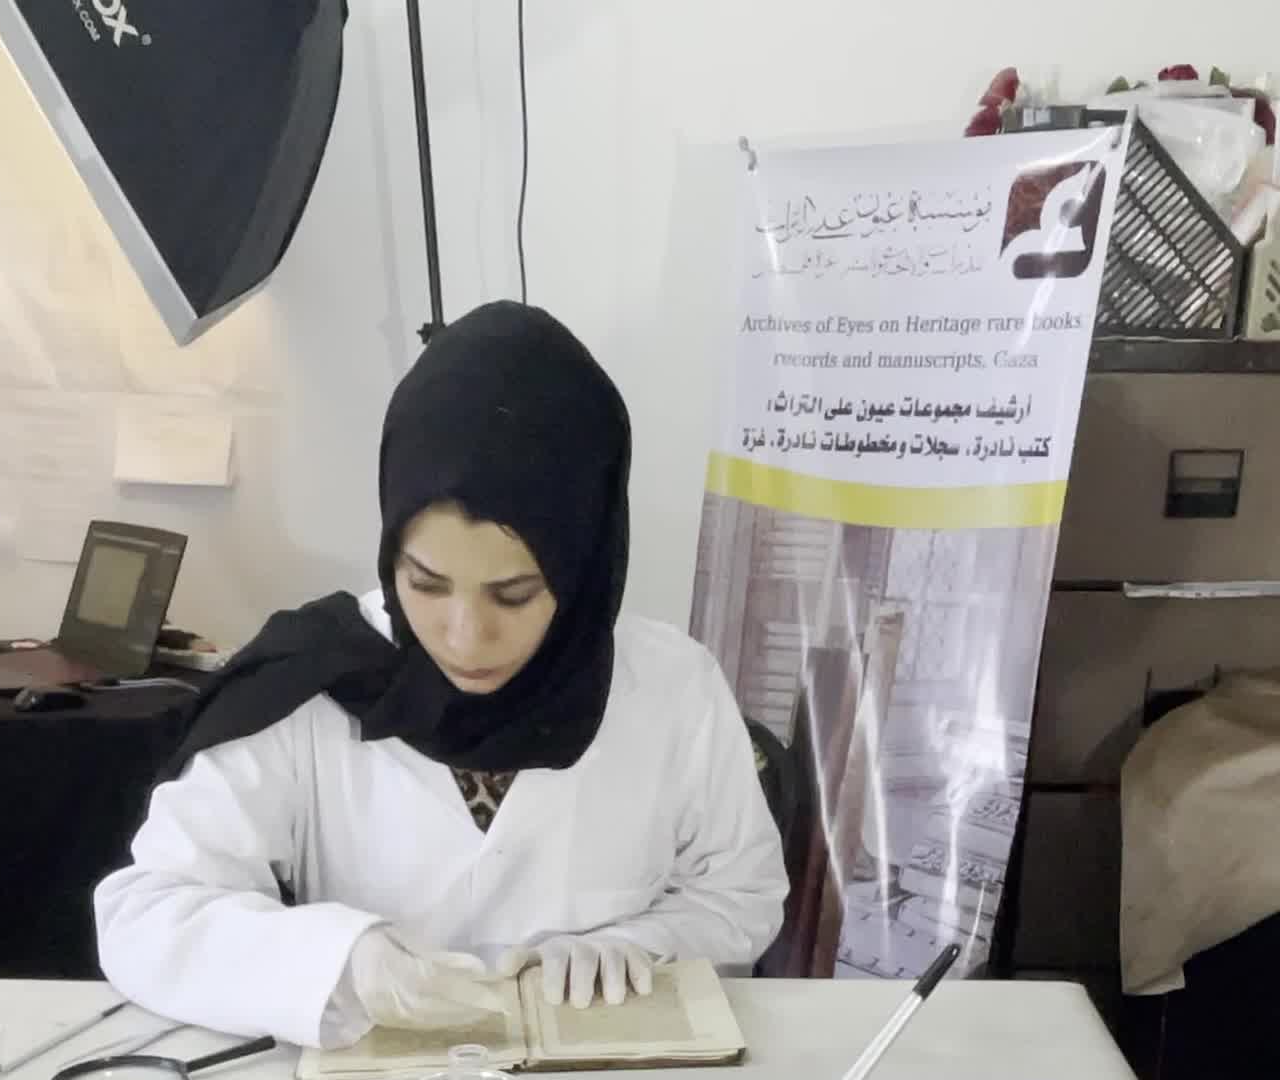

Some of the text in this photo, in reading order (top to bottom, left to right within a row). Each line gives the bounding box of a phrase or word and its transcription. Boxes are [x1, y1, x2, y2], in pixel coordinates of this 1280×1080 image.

[741, 314, 812, 333] Archives
[815, 315, 834, 333] of
[837, 316, 875, 337] Eyes
[878, 318, 900, 333] on
[905, 313, 981, 338] Heritage
[986, 317, 1026, 332] rare
[772, 351, 838, 369] records
[842, 350, 873, 369] and
[992, 350, 1039, 369] Gaza
[823, 398, 854, 421] على
[856, 397, 896, 423] عيون
[898, 396, 972, 423] مجموعات
[742, 425, 766, 448] غزة
[821, 430, 906, 459] ومخطوطات
[909, 432, 960, 461] سجلات
[1017, 435, 1053, 464] كتب
